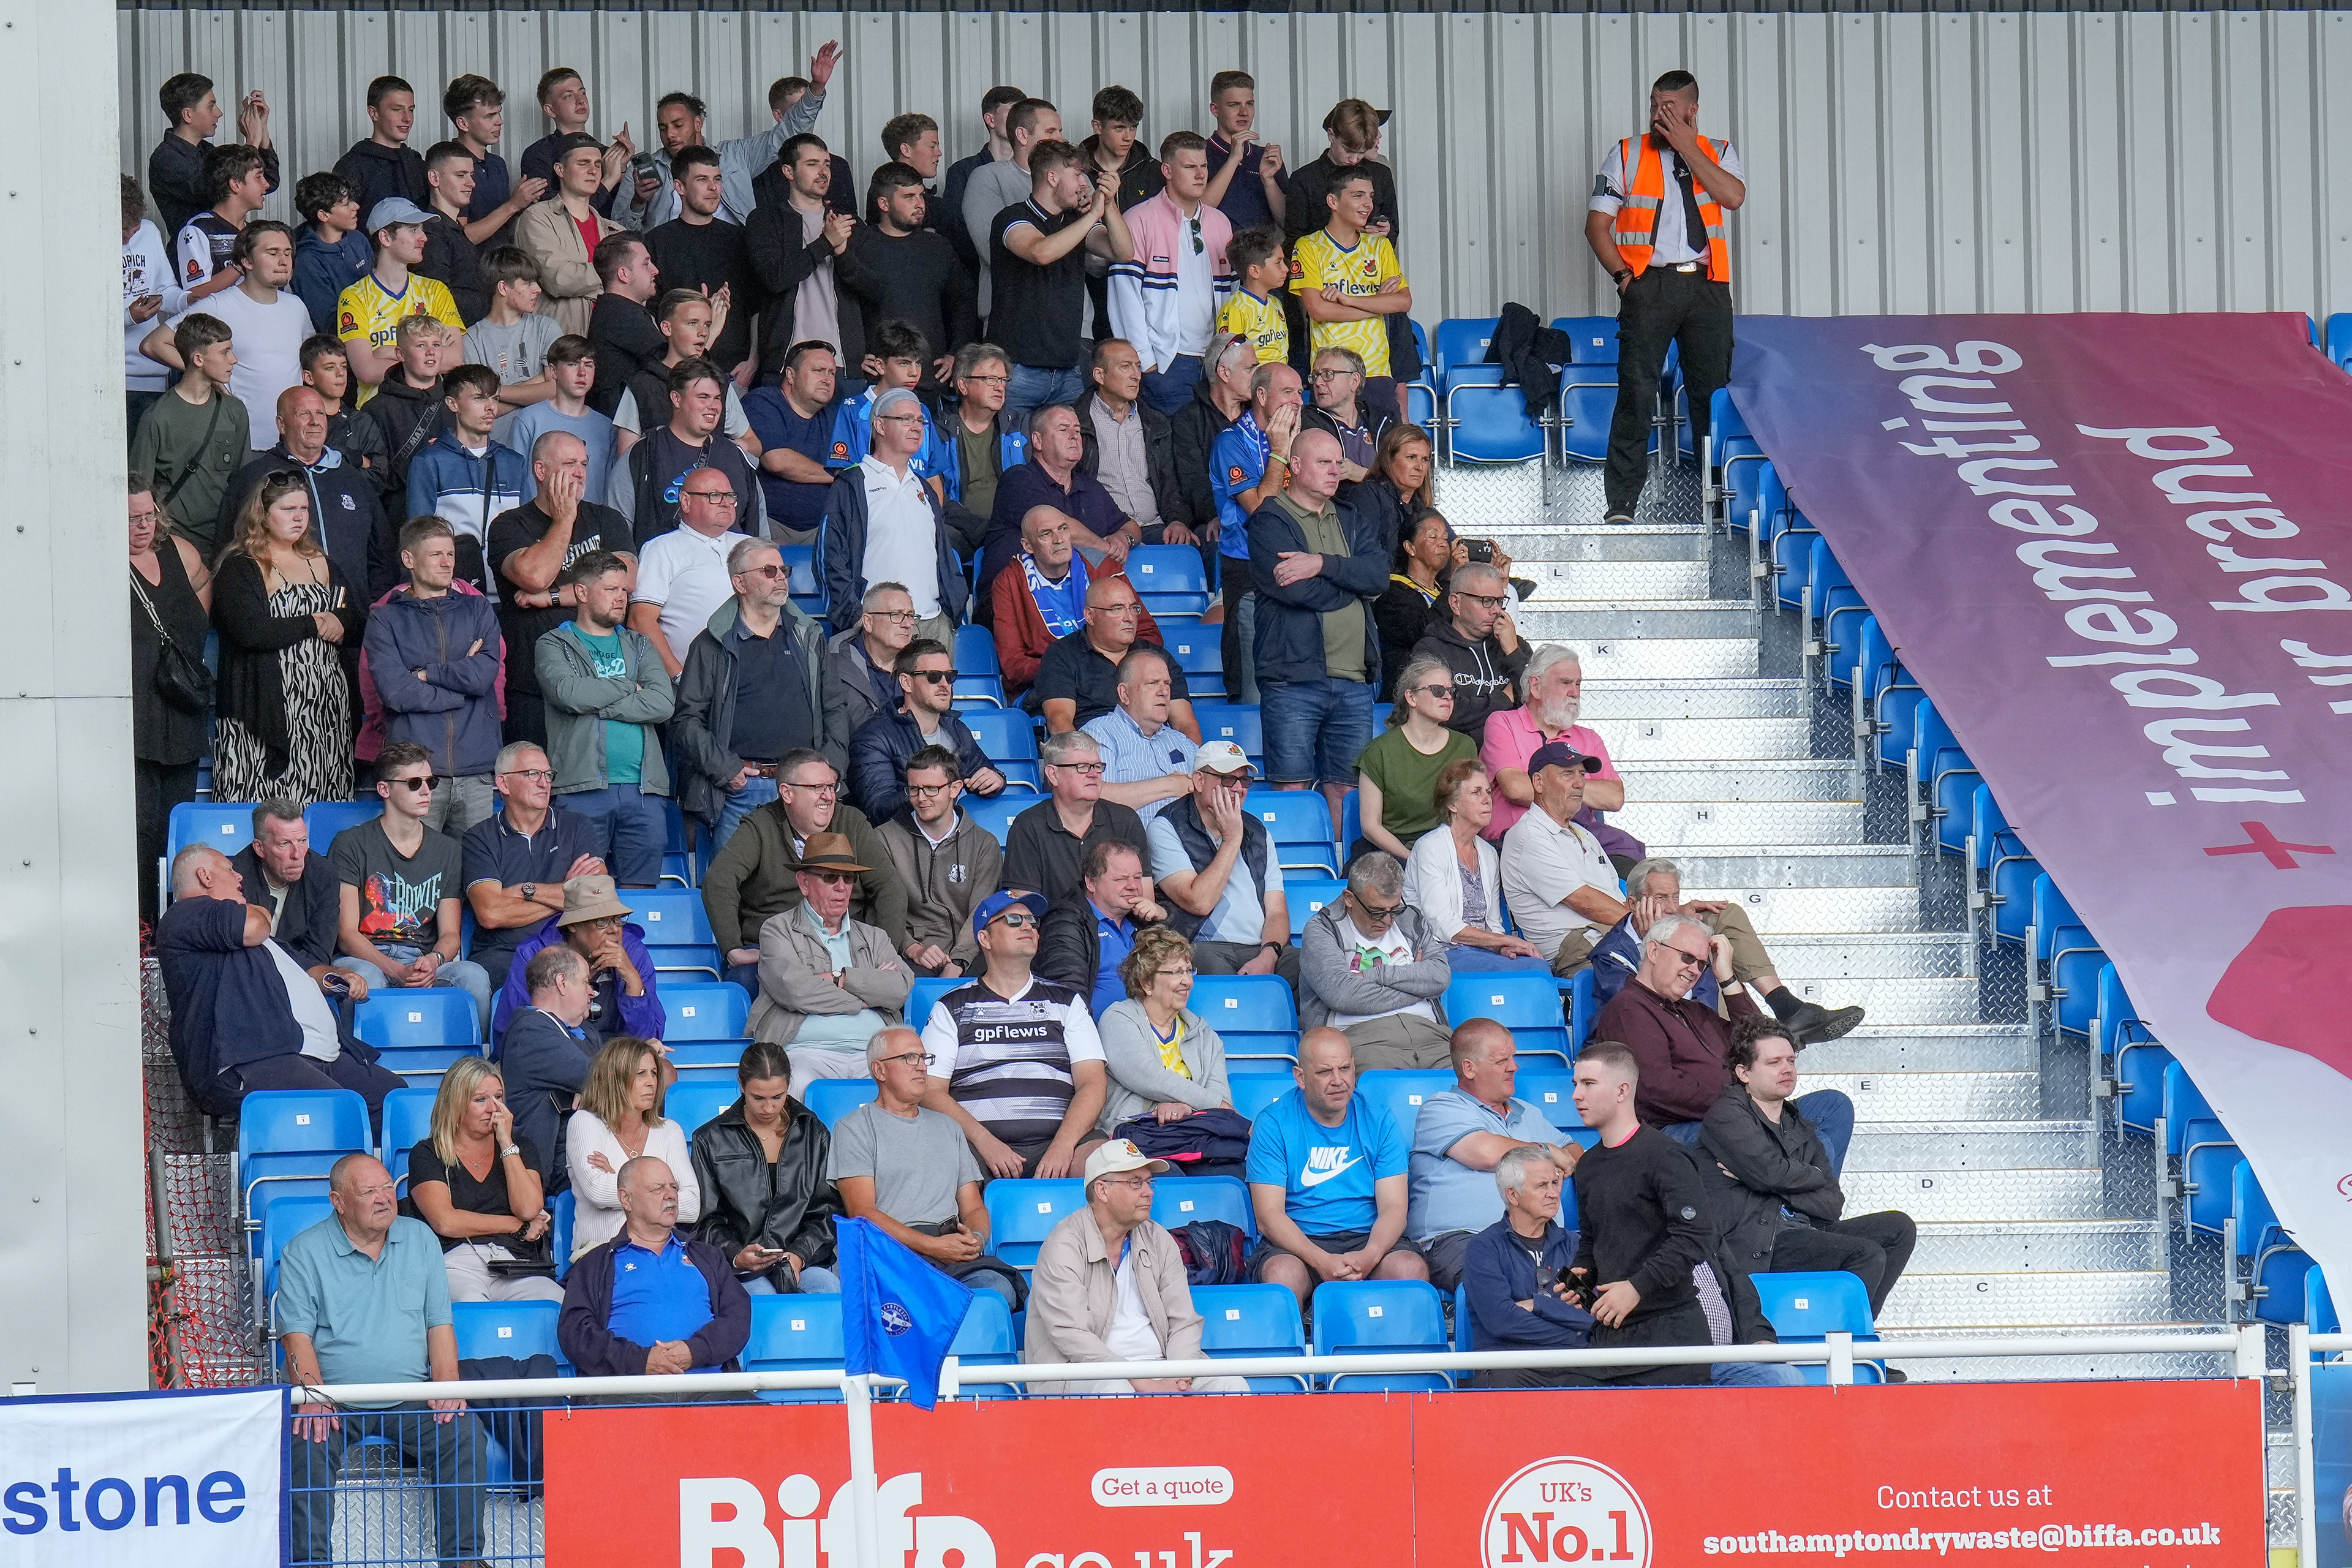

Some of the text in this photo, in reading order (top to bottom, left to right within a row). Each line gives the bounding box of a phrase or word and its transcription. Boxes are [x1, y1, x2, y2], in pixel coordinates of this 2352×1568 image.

[2075, 426, 2352, 612] brand
[1859, 341, 2306, 805] implementing
[394, 870, 442, 927] BOWIE
[1805, 986, 1814, 995] F
[974, 1025, 1048, 1042] gpflewis
[1861, 1081, 1871, 1090] E
[1309, 1146, 1350, 1169] NIKE
[1922, 1179, 1933, 1188] D
[1977, 1283, 1988, 1292] C
[1102, 1478, 1224, 1499] Get a quote
[1540, 1482, 1592, 1502] UK's
[1877, 1484, 2052, 1509] Contact us at
[2, 1468, 246, 1534] stone
[1501, 1510, 1634, 1562] No.1
[1703, 1522, 2220, 1558] southamptondrywaste@biffa.co.uk
